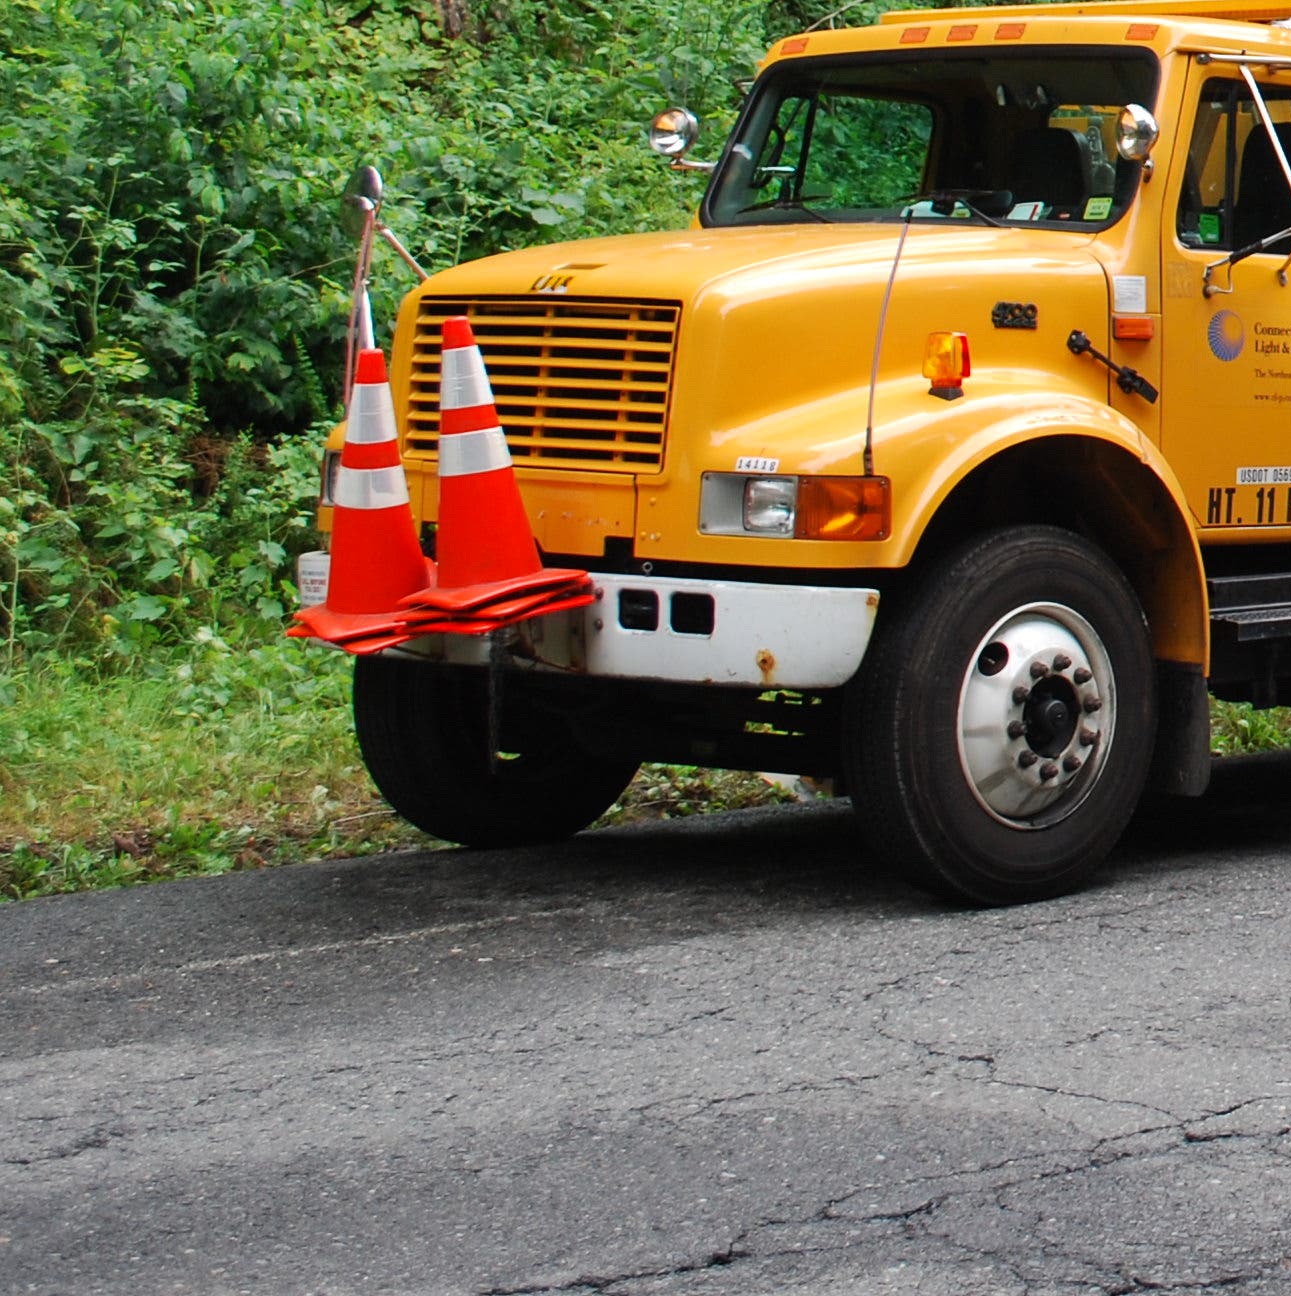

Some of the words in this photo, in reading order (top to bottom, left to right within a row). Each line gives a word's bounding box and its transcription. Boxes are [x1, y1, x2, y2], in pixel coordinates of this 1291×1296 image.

[1254, 339, 1281, 358] Light
[1281, 342, 1290, 354] &
[737, 458, 777, 472] 14118
[1240, 468, 1269, 483] USDOT
[1207, 487, 1243, 524] HT.
[1256, 487, 1276, 523] 11
